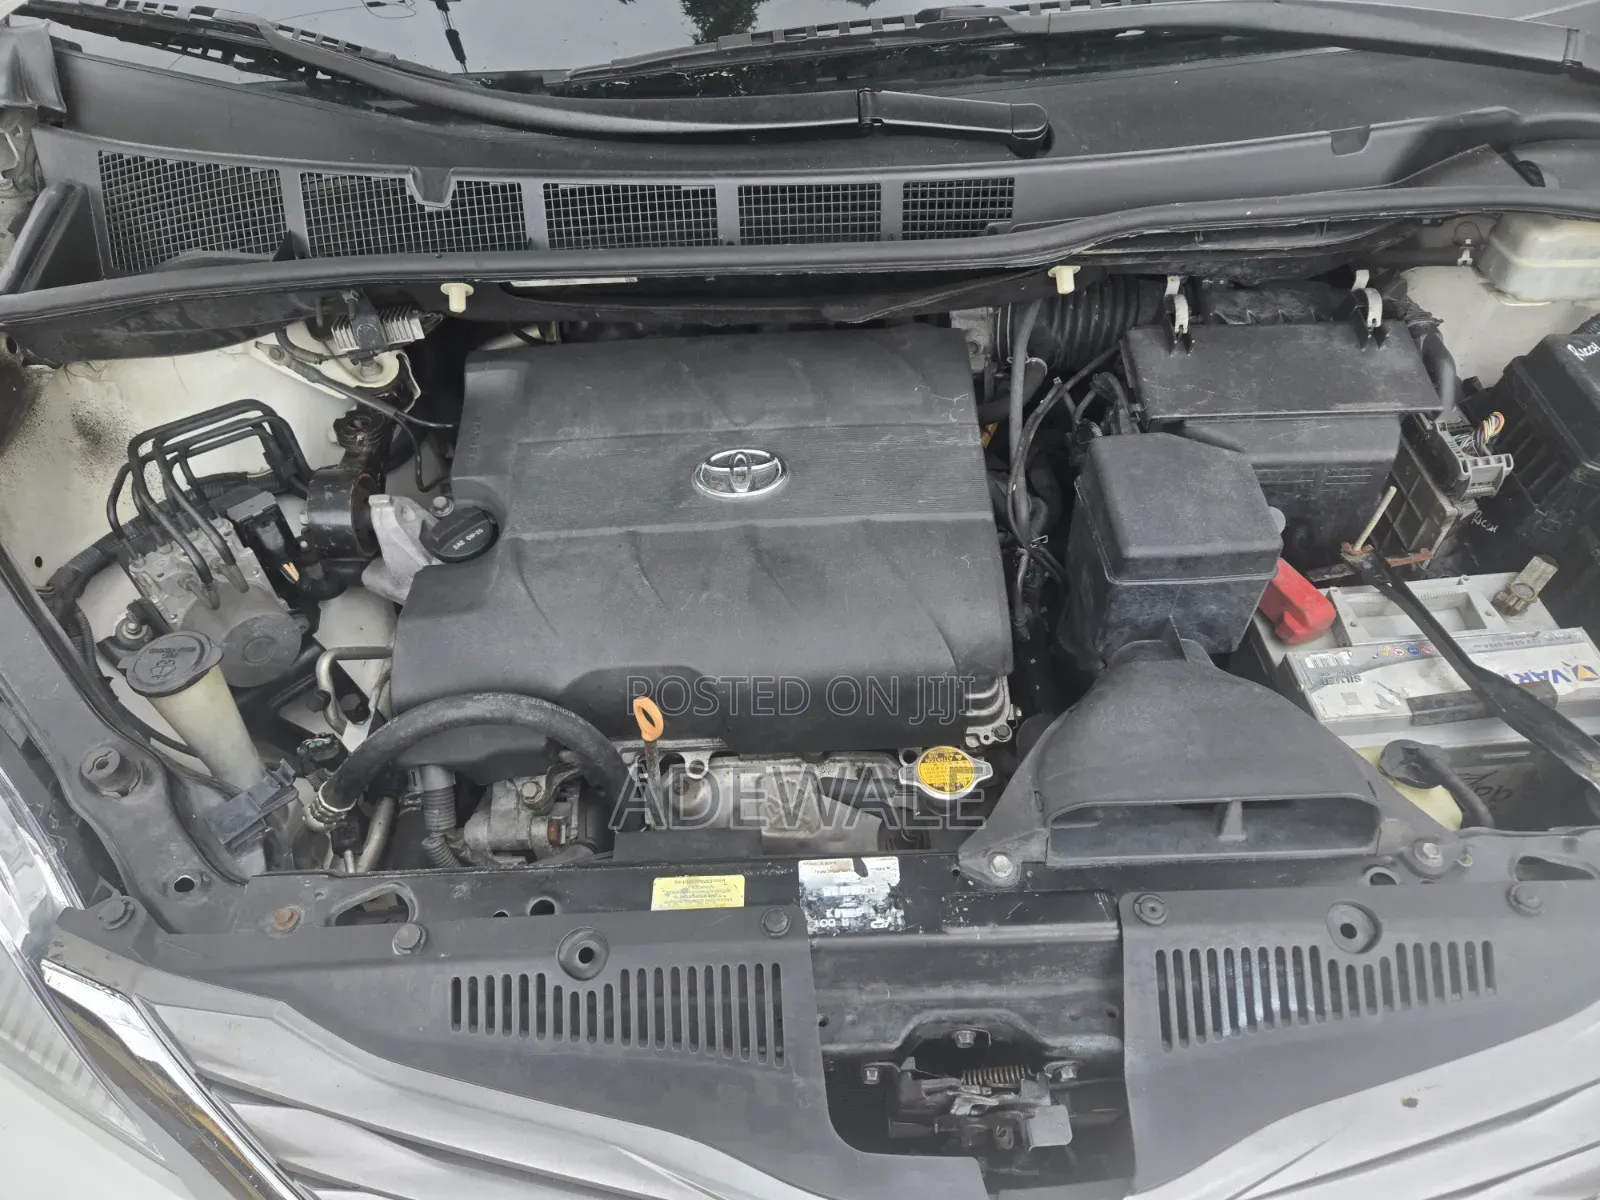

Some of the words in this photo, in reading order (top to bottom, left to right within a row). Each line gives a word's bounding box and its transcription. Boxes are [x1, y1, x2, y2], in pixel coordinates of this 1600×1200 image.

[452, 540, 466, 550] SAE
[465, 528, 484, 541] 0W-20
[1321, 675, 1362, 686] SILVER
